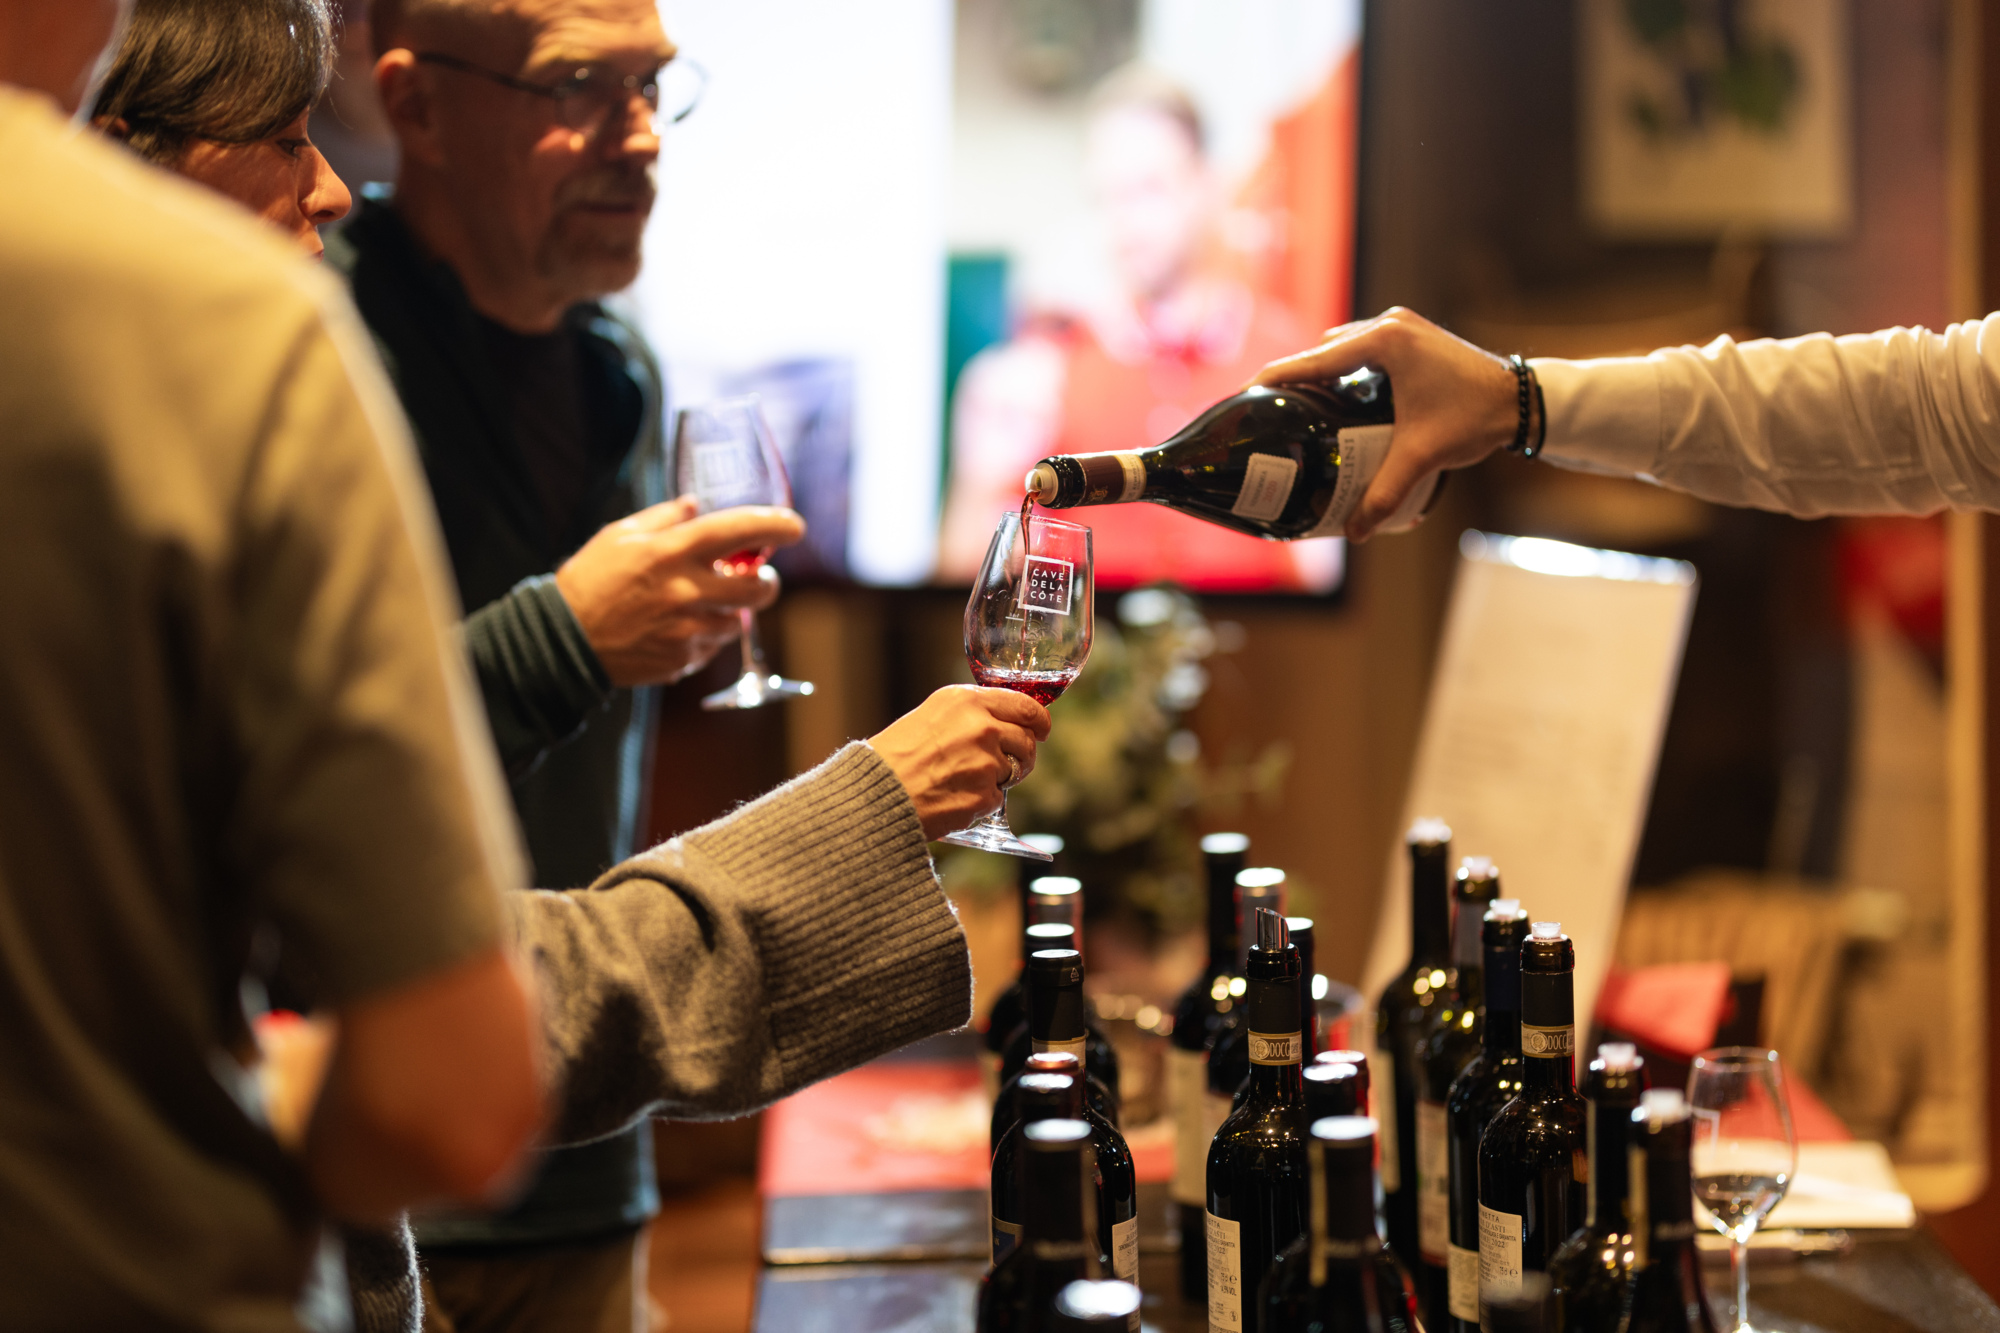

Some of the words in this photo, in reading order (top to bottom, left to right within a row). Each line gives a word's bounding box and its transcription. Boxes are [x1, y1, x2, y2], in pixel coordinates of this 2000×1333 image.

[1262, 480, 1277, 503] 2020
[1032, 568, 1064, 581] CAVE
[1030, 590, 1062, 603] CÔTE
